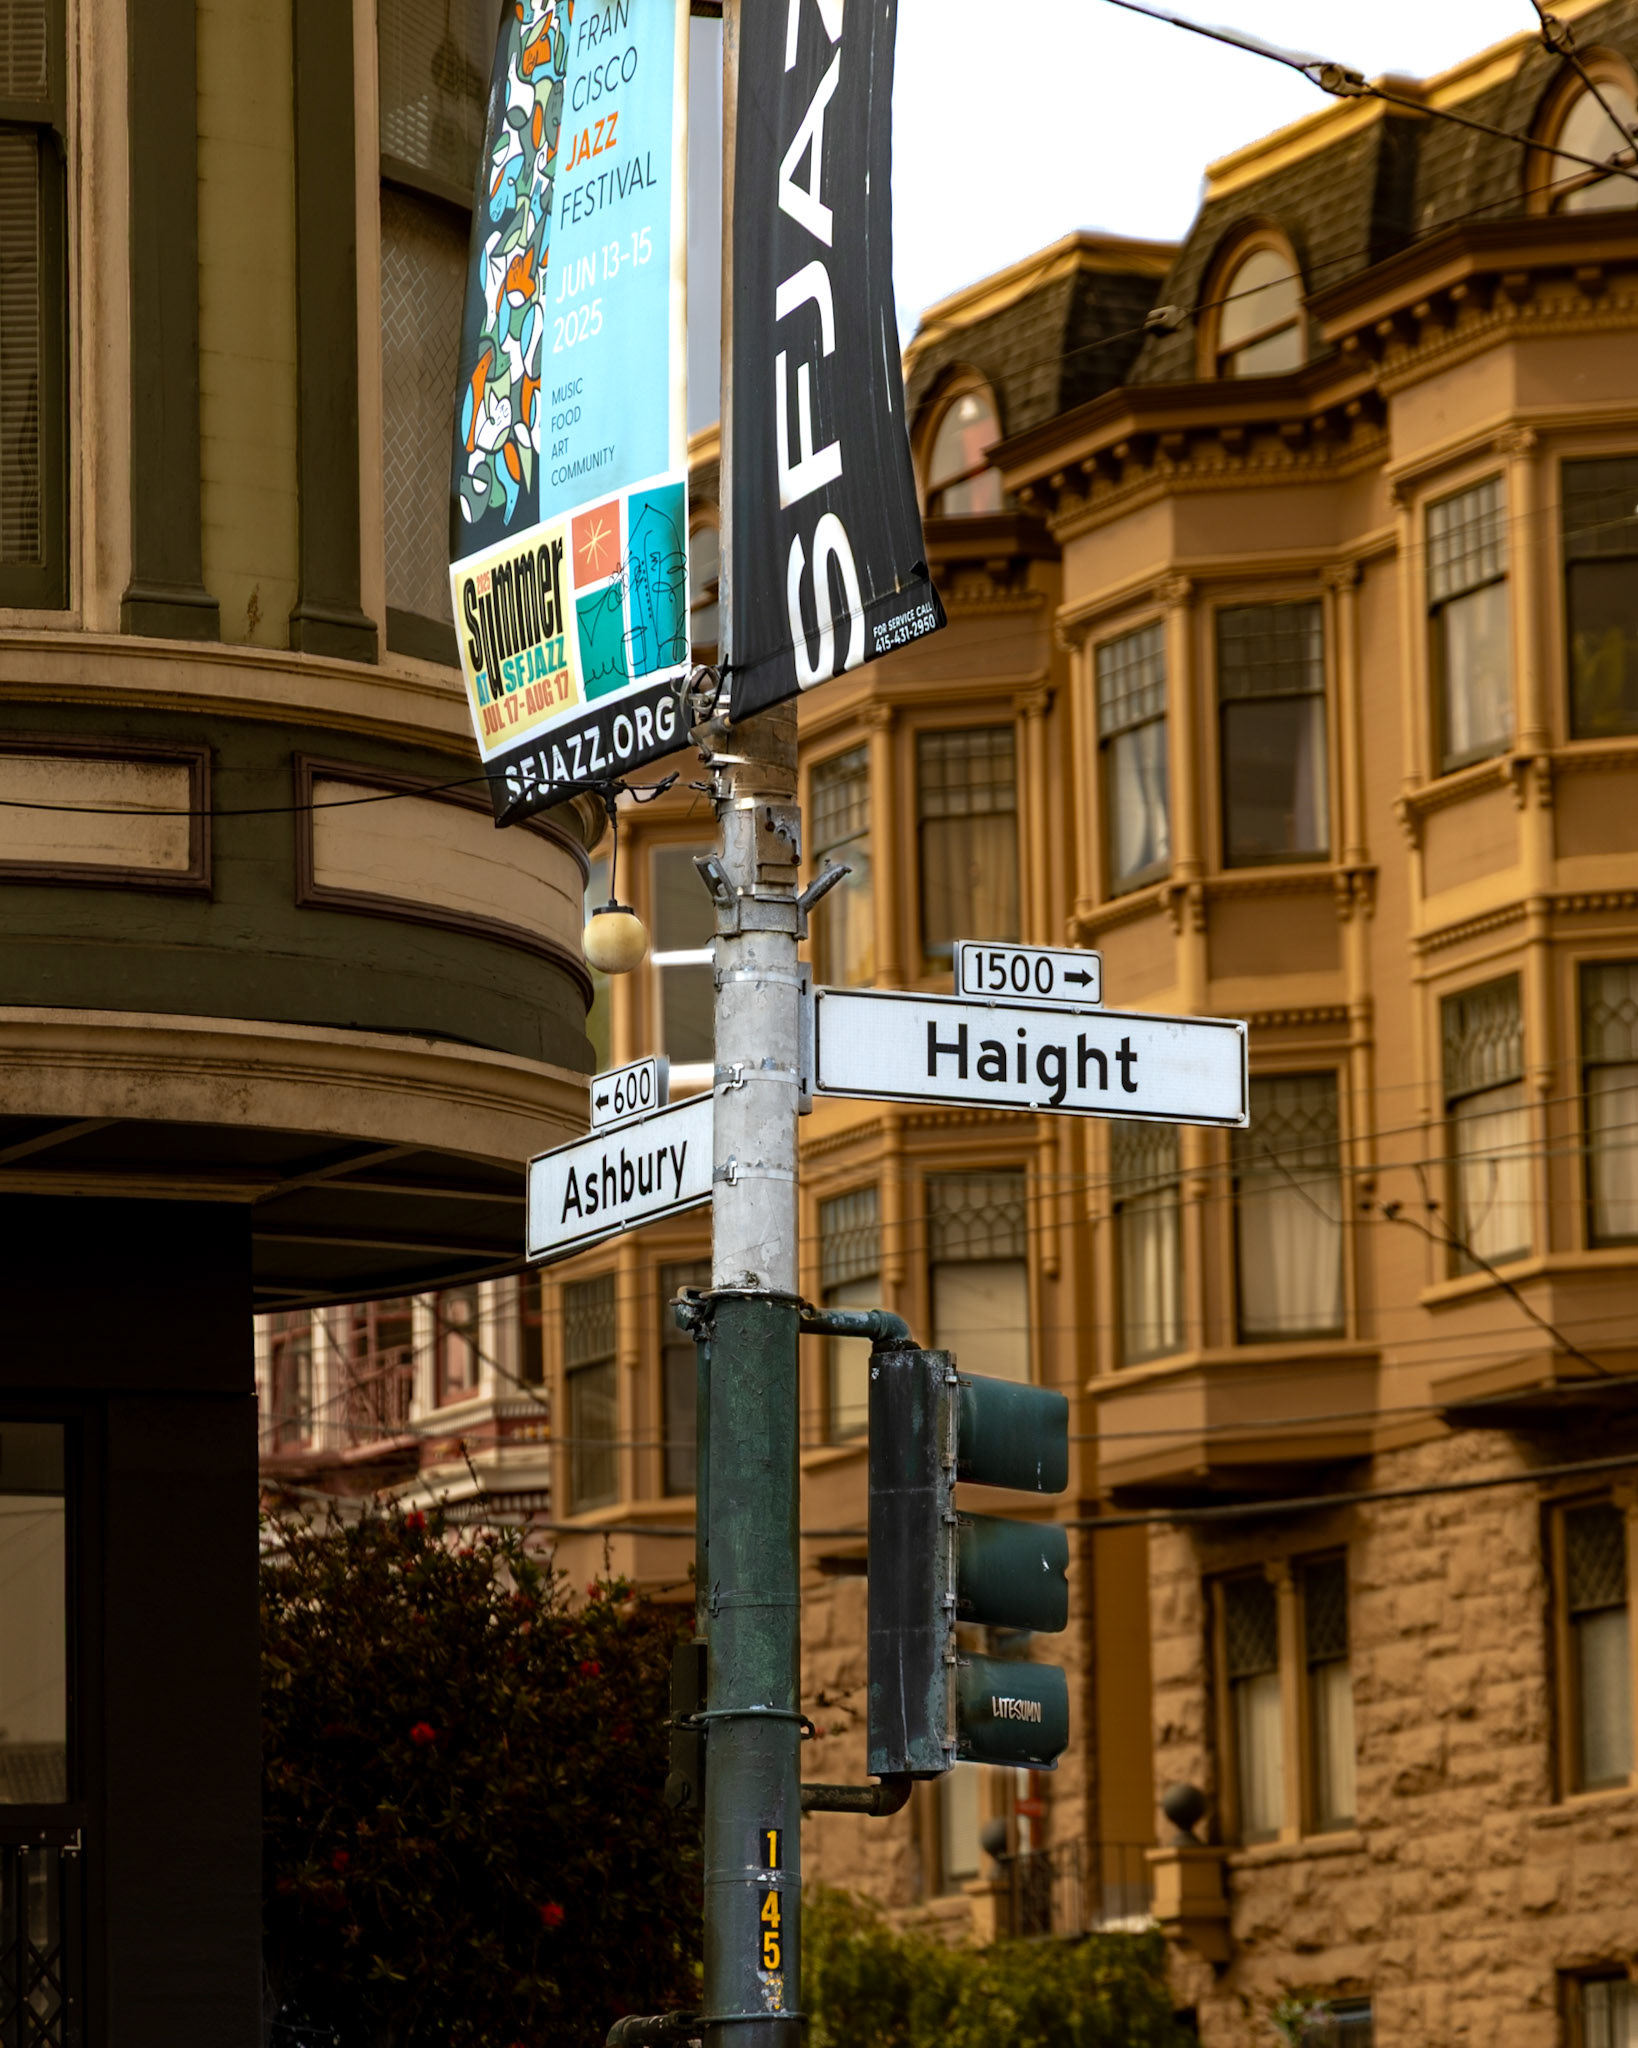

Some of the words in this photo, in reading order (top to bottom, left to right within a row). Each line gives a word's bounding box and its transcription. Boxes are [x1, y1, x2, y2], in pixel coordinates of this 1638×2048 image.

[576, 0, 630, 57] FRAN
[572, 45, 638, 111] CISCO
[565, 110, 619, 172] JAZZ
[560, 150, 657, 231] FESTIVAL
[556, 250, 596, 304] JUN
[602, 225, 652, 281] 13-15
[552, 297, 603, 354] 2025
[551, 377, 583, 406] MUSIC
[551, 405, 581, 432] FOOD
[551, 436, 569, 460] ART
[551, 444, 615, 487] COMMUNITY
[476, 570, 491, 596] 2025
[463, 536, 563, 701] Summer
[873, 622, 887, 638] FOR
[888, 608, 915, 631] SERVICE
[915, 601, 933, 617] CALL
[875, 613, 936, 653] 415-431-2950
[475, 671, 491, 707] AT
[502, 634, 568, 693] SFJAZZ
[482, 702, 506, 736] JUL
[554, 669, 569, 701] 17
[504, 695, 676, 802] SFJAZZ.ORG
[975, 951, 1054, 994] 1500
[613, 1067, 651, 1114] 600
[926, 1020, 1138, 1106] Haight
[560, 1139, 688, 1224] Ashbury
